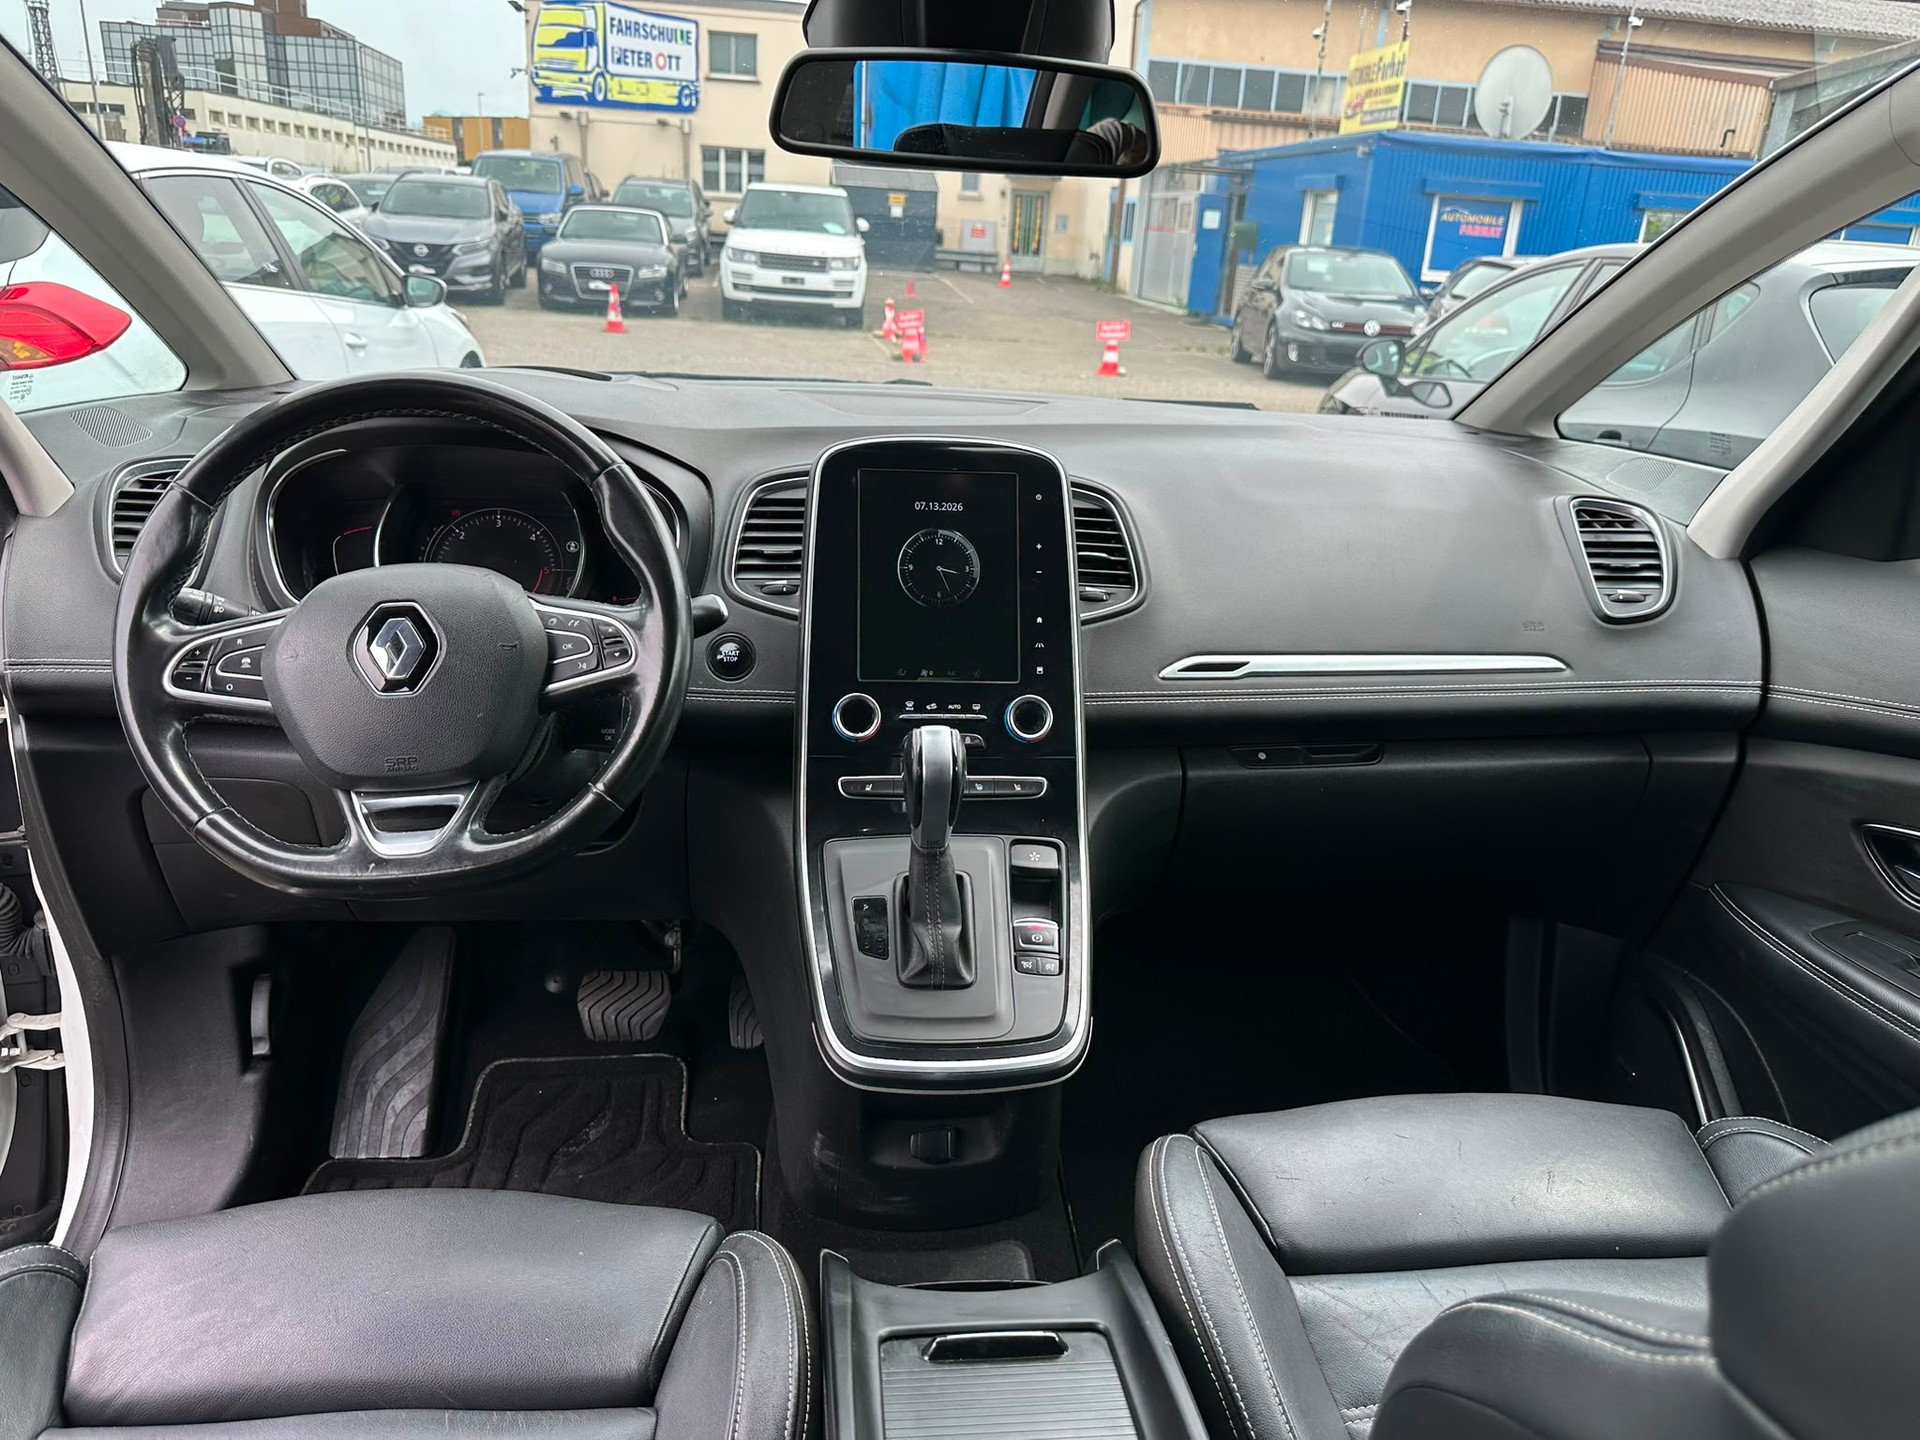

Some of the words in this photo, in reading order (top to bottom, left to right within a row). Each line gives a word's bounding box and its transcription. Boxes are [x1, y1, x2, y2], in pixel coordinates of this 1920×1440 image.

[610, 17, 692, 45] FAHRSCHULE
[611, 45, 653, 69] PETER
[655, 51, 682, 71] OTT
[1441, 210, 1505, 225] AUTOMOBILE
[914, 501, 964, 512] 07.13.2026
[495, 519, 502, 528] 3
[459, 531, 465, 540] 2
[529, 533, 536, 542] 4
[935, 538, 944, 546] 12
[908, 562, 914, 571] 9
[964, 565, 970, 573] 3
[385, 756, 418, 767] SRP
